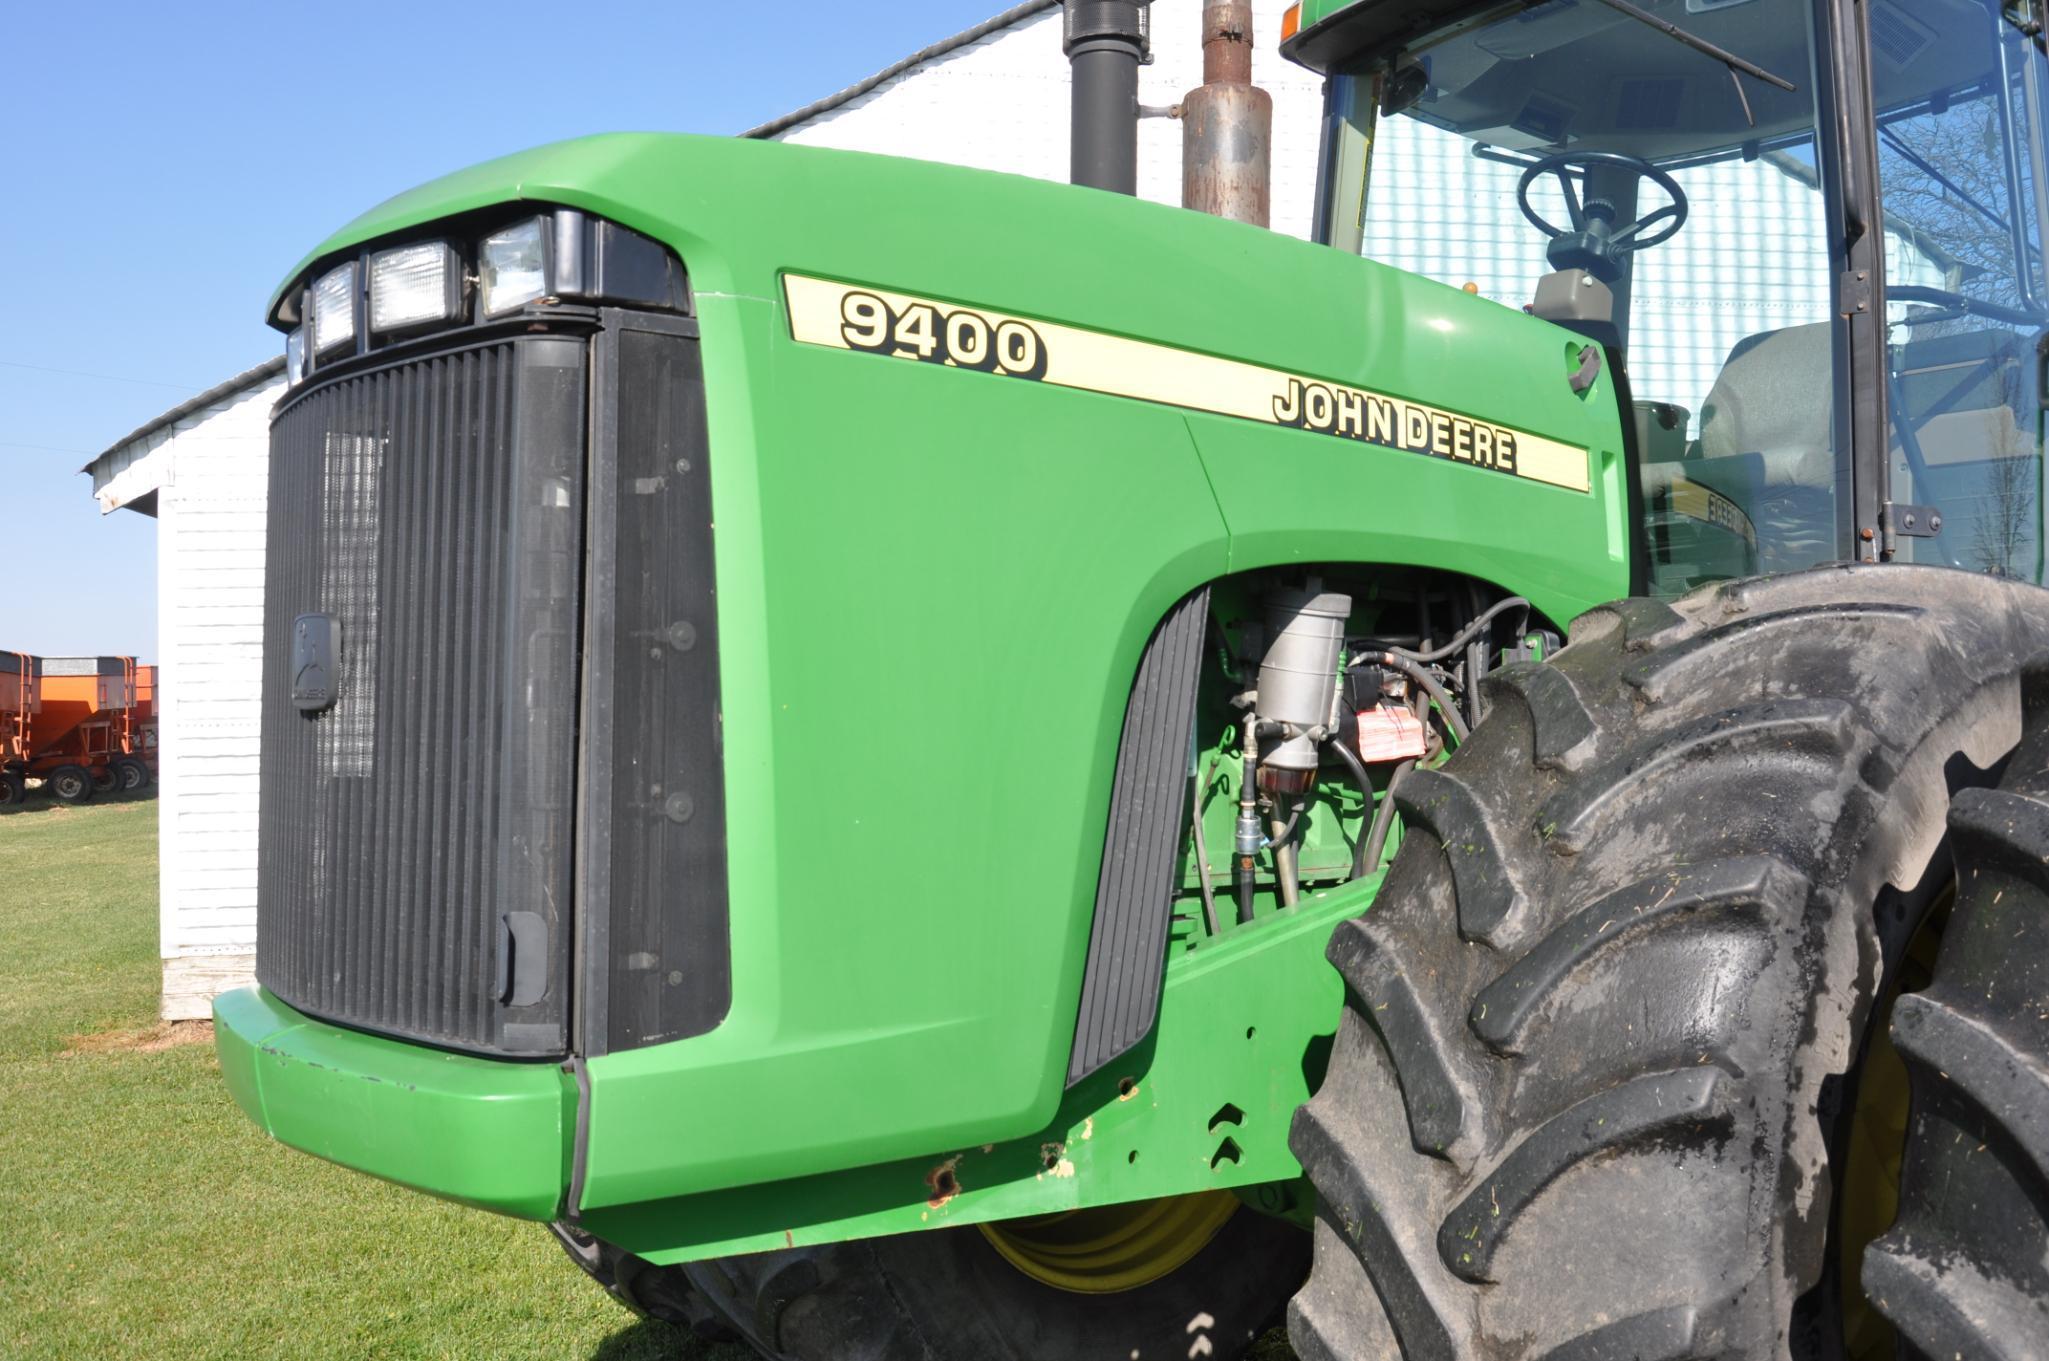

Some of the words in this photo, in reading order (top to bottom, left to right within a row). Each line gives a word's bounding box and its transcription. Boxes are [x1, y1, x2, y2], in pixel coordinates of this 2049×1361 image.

[840, 291, 1048, 381] 9400
[1272, 378, 1399, 447] JOHN
[1404, 405, 1517, 475] DEERE
